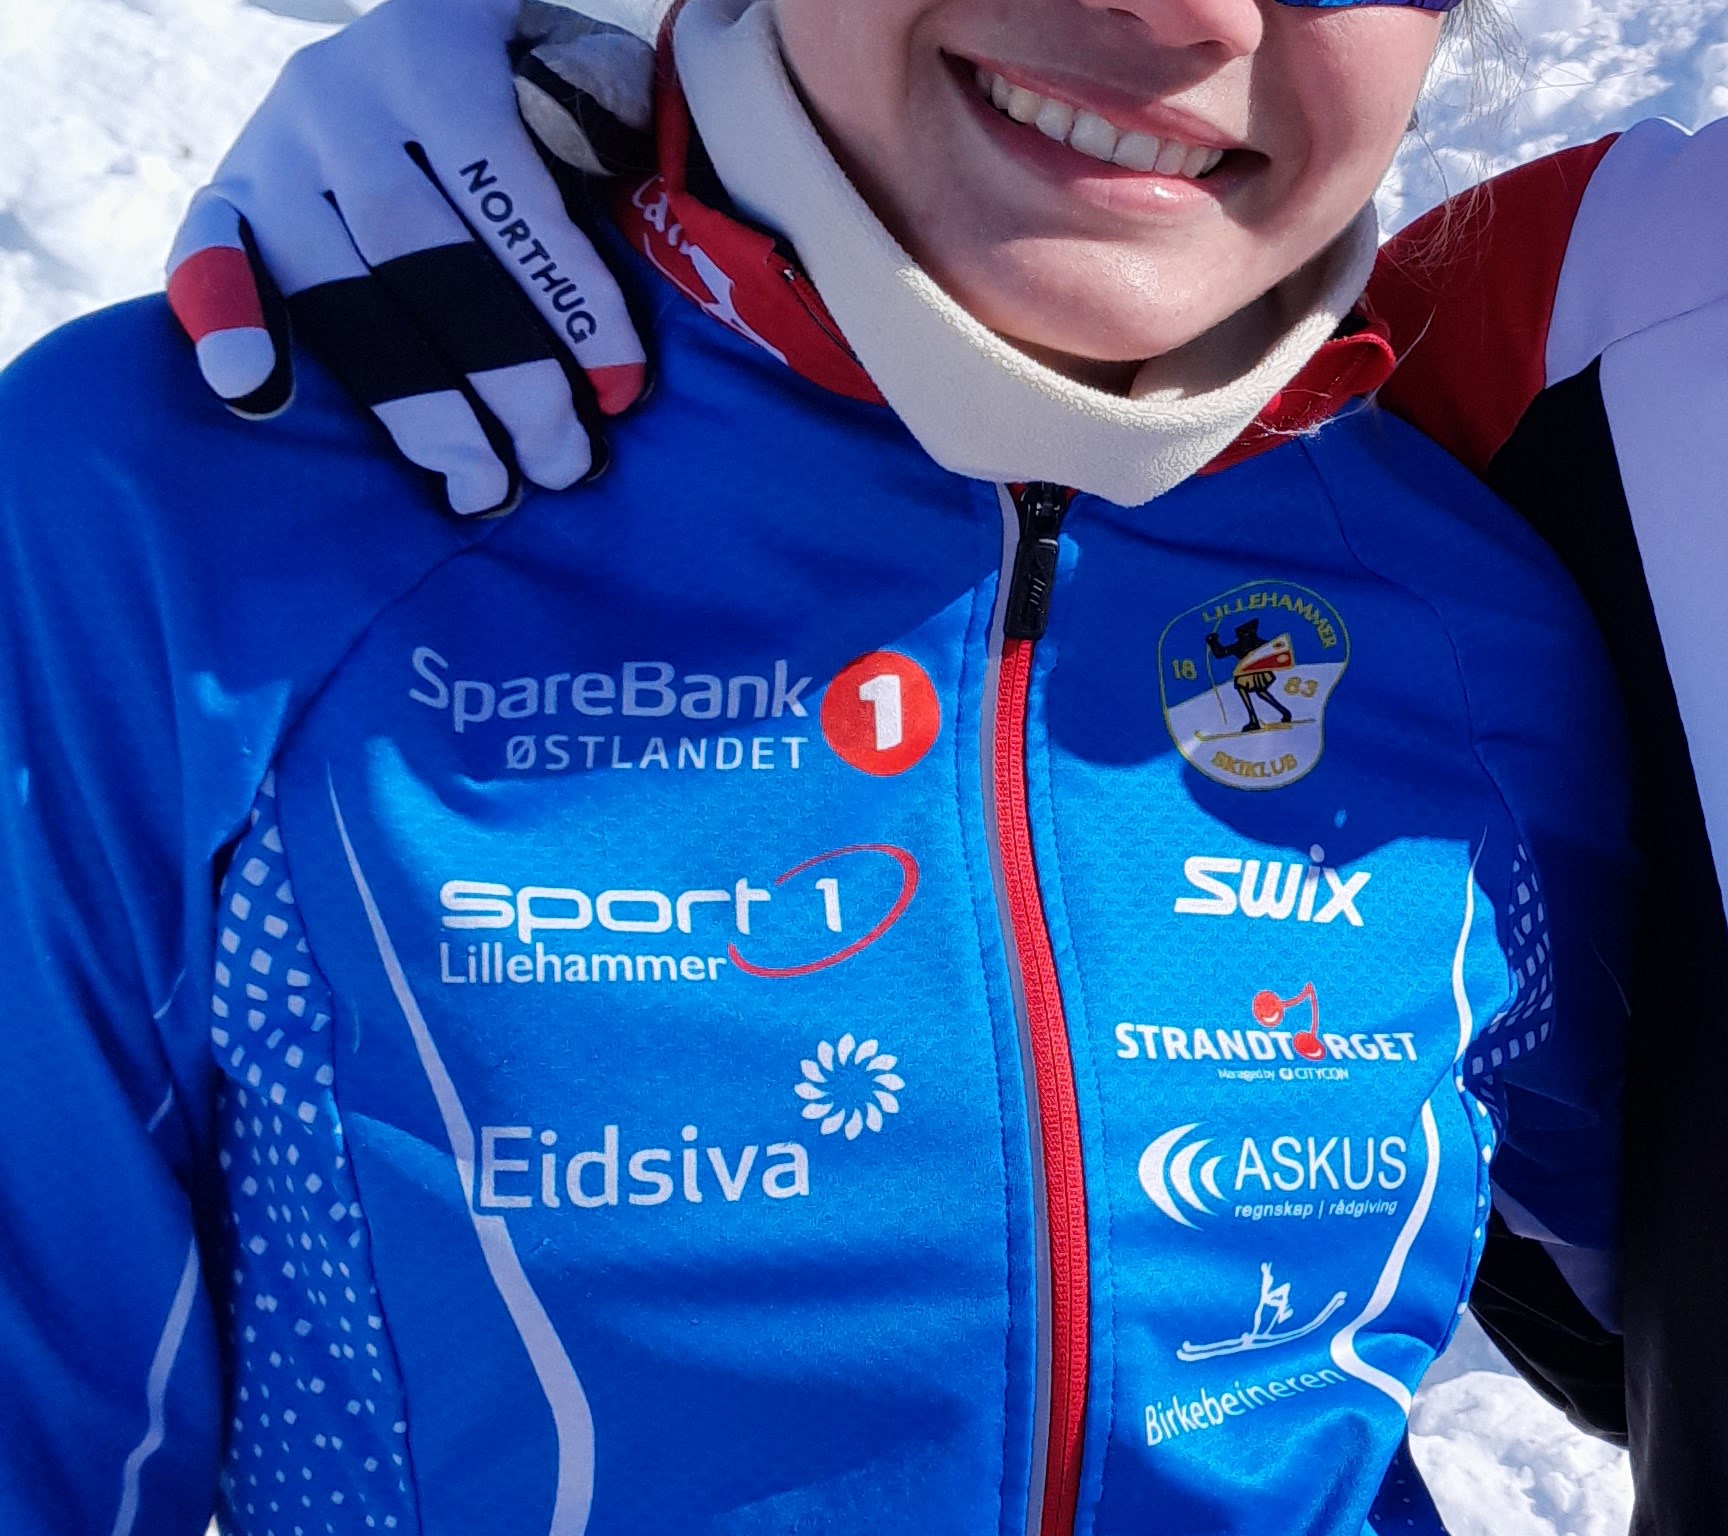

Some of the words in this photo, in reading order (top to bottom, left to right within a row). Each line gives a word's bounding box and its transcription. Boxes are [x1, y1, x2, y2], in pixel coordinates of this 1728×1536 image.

[459, 159, 598, 345] NORTHUG
[1202, 592, 1337, 649] LILLEHAMMER
[1172, 659, 1197, 680] 18
[1284, 677, 1318, 698] 83
[408, 646, 812, 732] SpareBank
[858, 674, 902, 751] 1
[506, 734, 808, 770] ØSTLANDET
[1211, 750, 1298, 778] SKIKLUB
[440, 878, 772, 945] sport
[815, 878, 842, 933] 1
[441, 942, 727, 984] Lillehammer
[1295, 1067, 1349, 1081] CITYCON
[479, 1125, 810, 1209] Eidsiva
[1234, 1135, 1407, 1192] ASKUS
[1234, 1202, 1314, 1219] regnskap
[1329, 1199, 1398, 1218] rådgiving
[1144, 1365, 1348, 1447] Birkebeineren
